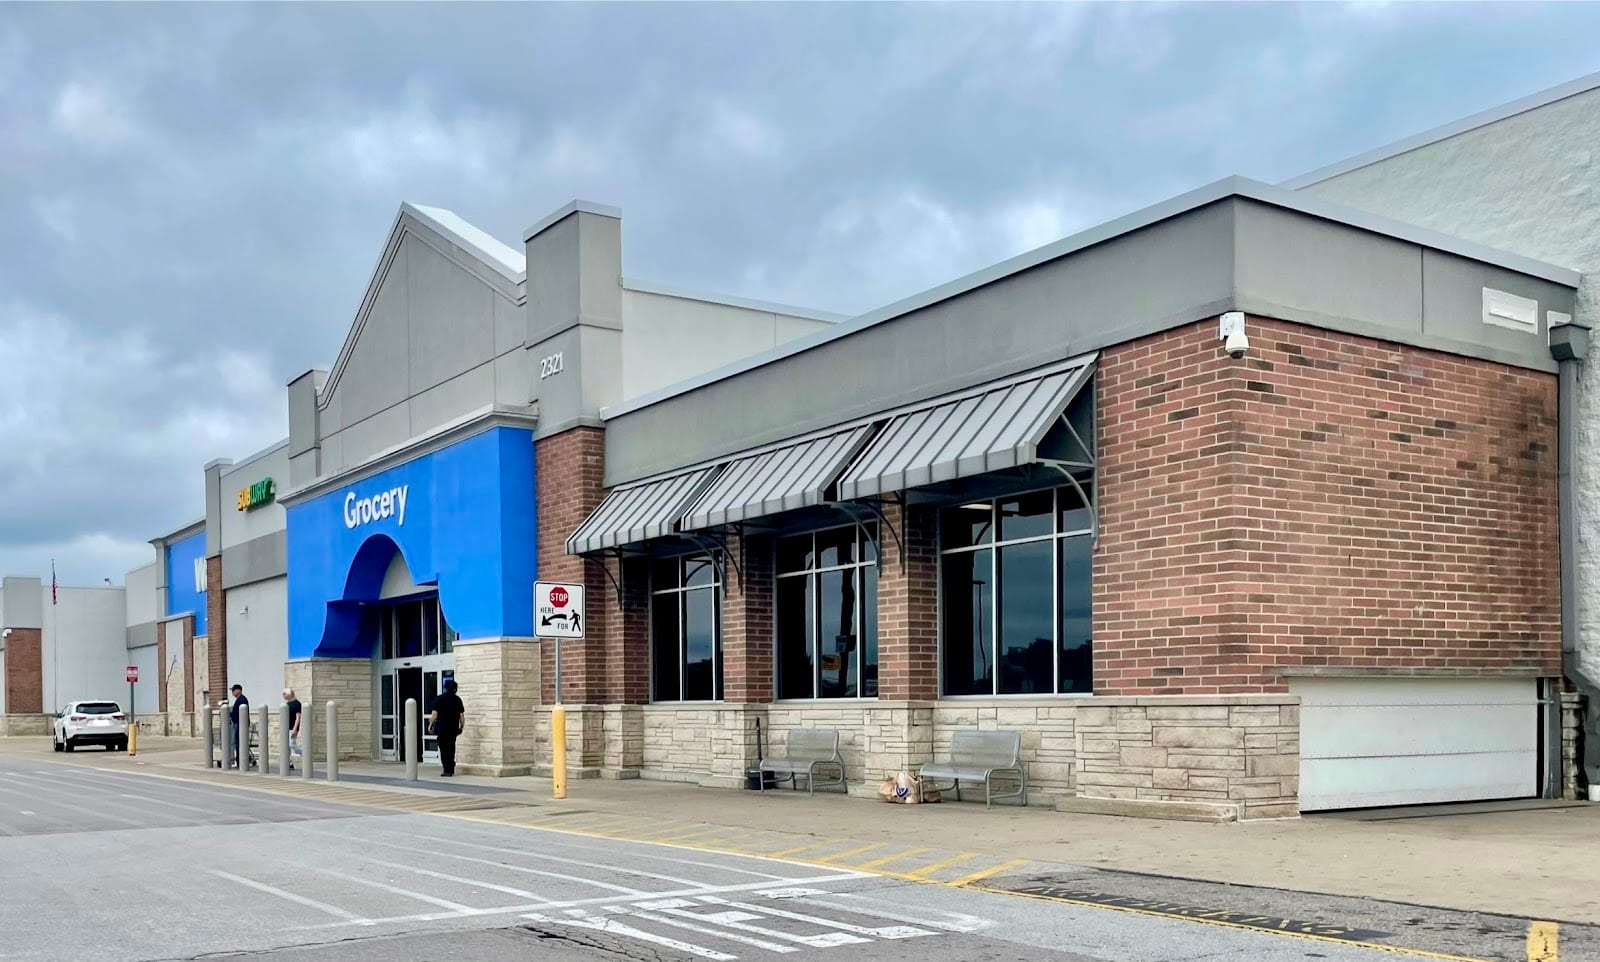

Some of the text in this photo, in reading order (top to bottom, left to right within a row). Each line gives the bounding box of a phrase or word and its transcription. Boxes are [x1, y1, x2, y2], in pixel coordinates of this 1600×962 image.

[540, 351, 564, 379] 2321
[237, 477, 273, 511] SUBWAY
[344, 484, 409, 529] Grocery
[550, 593, 568, 602] STOP
